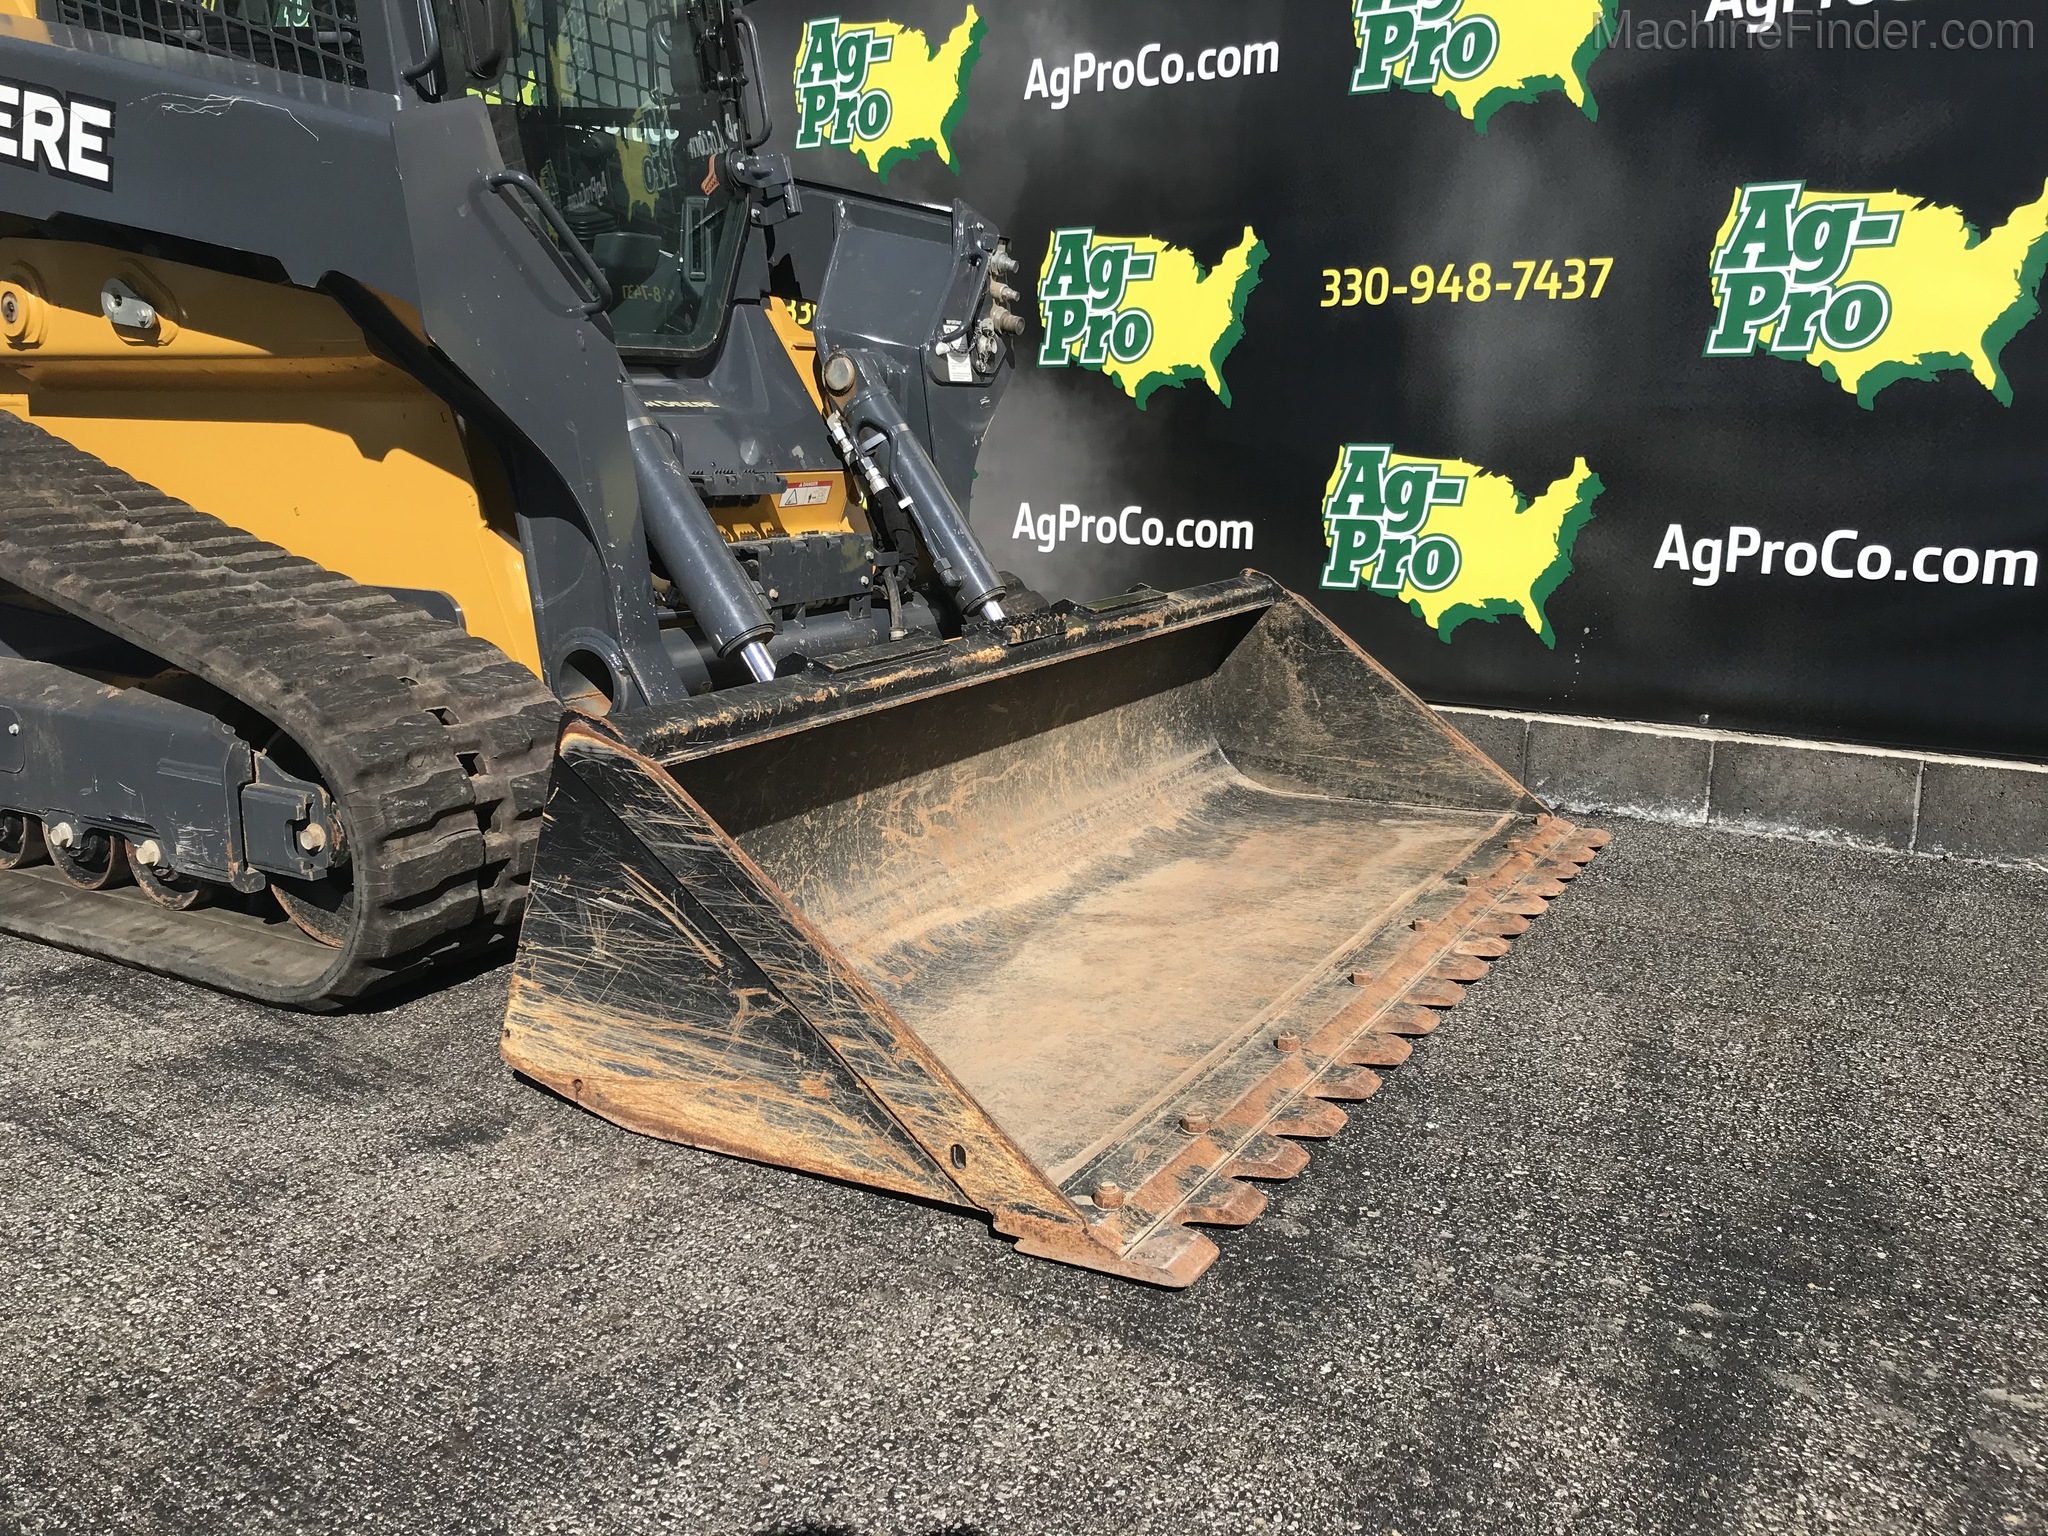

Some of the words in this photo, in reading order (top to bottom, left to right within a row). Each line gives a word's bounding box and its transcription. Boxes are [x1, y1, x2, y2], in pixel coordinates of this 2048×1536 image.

[796, 17, 893, 95] Ag-
[1024, 41, 1279, 110] AgProCo.com
[1351, 10, 1498, 92] Pro
[796, 85, 892, 149] Pro
[1040, 228, 1155, 312] Ag-
[1713, 183, 1900, 287] Ag-
[1320, 257, 1615, 307] 330-948-7437
[1706, 271, 1889, 354] Pro
[1039, 298, 1152, 365] Pro
[1012, 502, 1254, 553] AgProCo.com
[1325, 446, 1465, 535] Ag-
[1322, 517, 1460, 591] Pro
[1653, 523, 2039, 587] AgProCo.com
